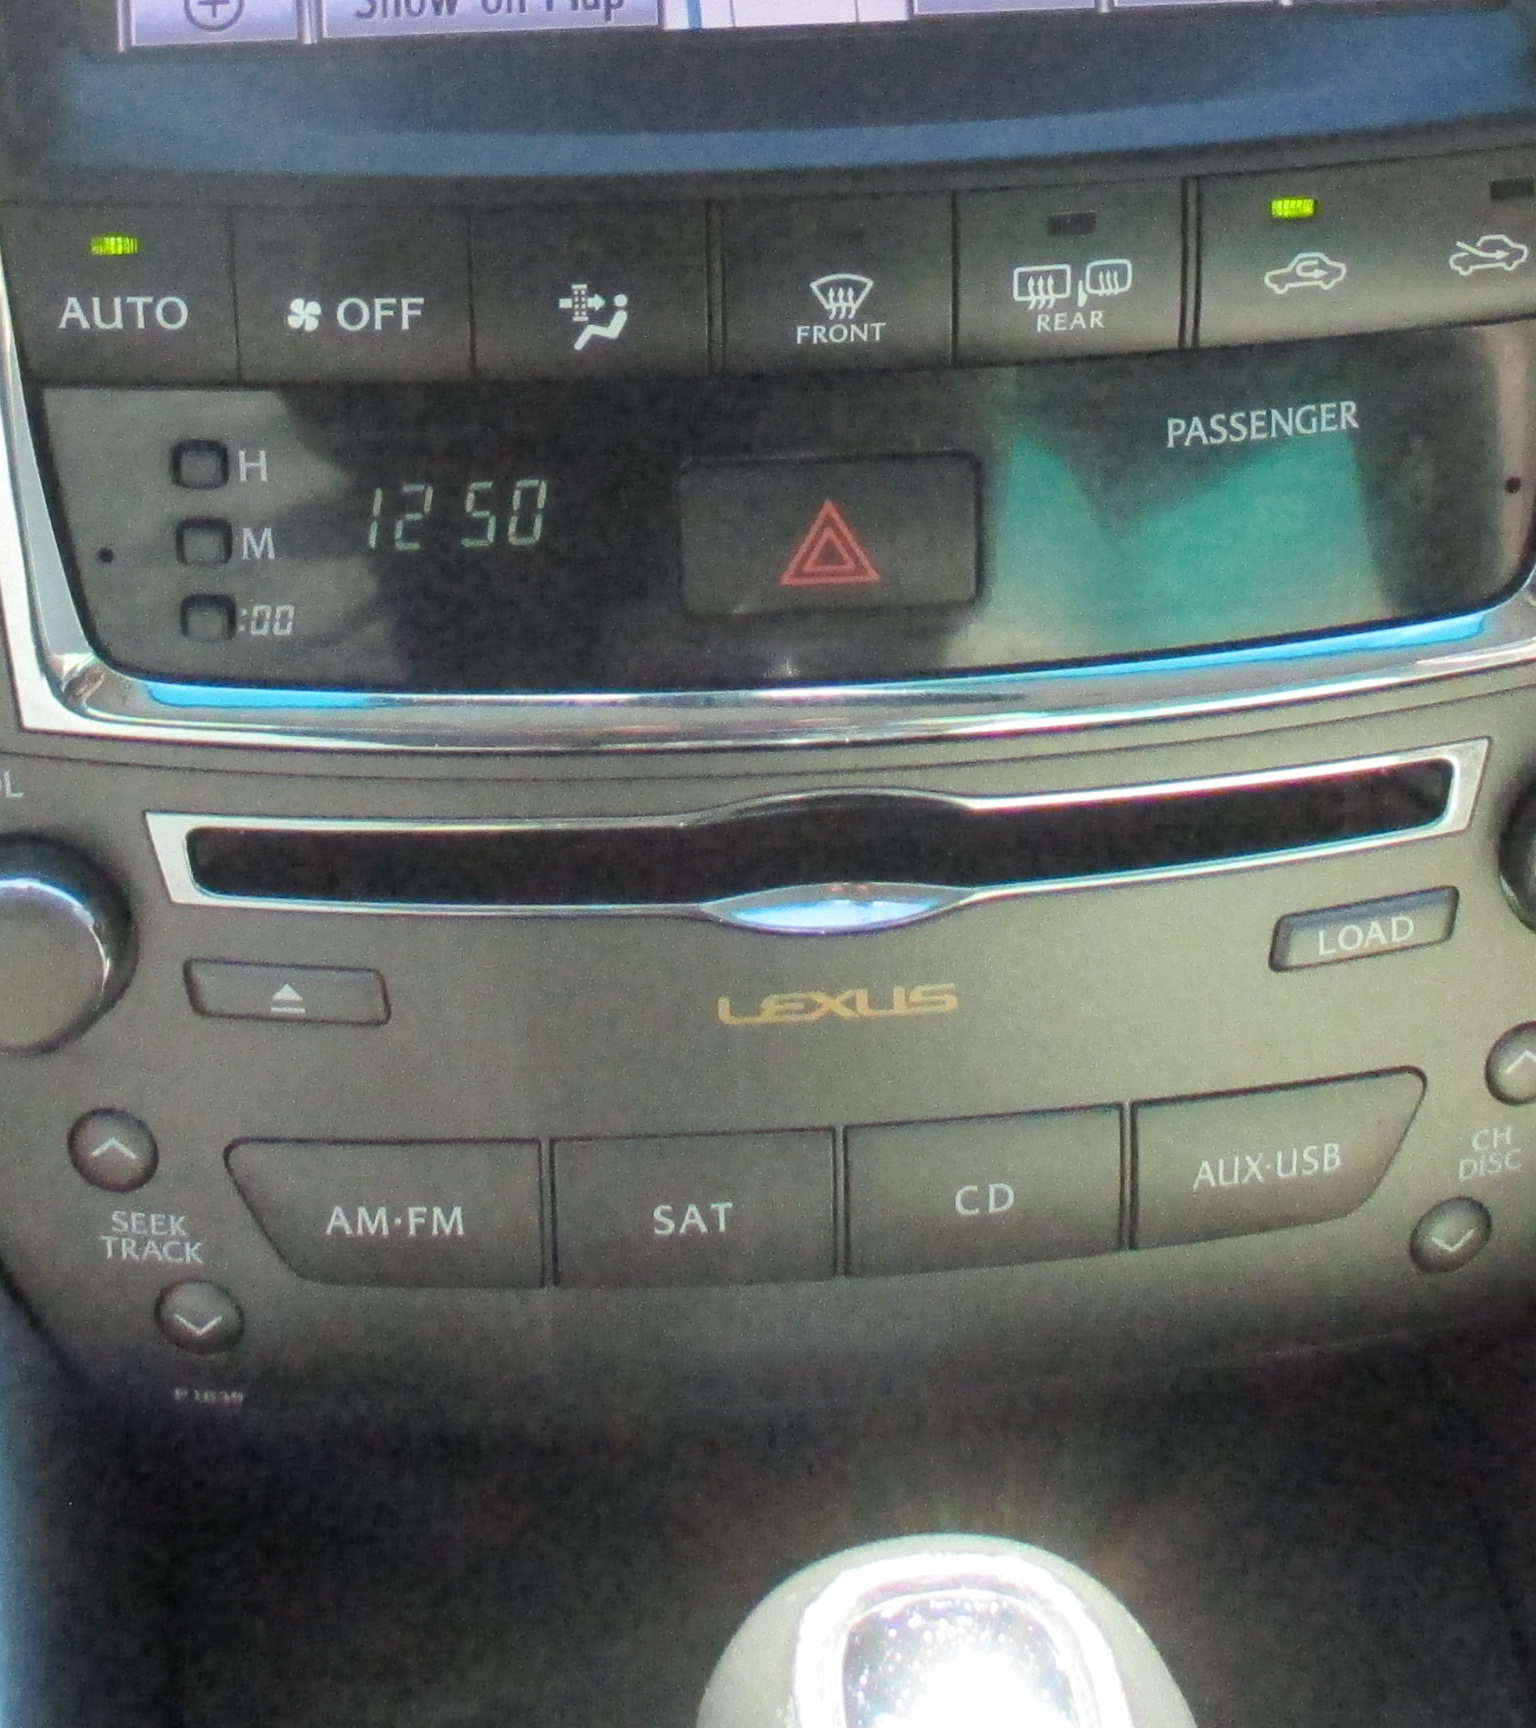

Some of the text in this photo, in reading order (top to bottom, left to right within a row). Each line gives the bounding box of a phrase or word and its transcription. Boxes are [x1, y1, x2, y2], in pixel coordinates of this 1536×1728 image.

[57, 294, 190, 332] AUTO
[335, 296, 425, 333] OFF
[1036, 309, 1106, 333] REAR
[795, 321, 886, 345] FRONT
[1165, 399, 1361, 450] PASSENGER
[237, 450, 269, 485] H
[241, 526, 276, 560] M
[1315, 913, 1416, 957] LOAD
[716, 981, 959, 1026] LEXUS
[1470, 1123, 1515, 1157] CH
[1456, 1146, 1524, 1186] DISC
[953, 1182, 1016, 1217] CD
[110, 1208, 188, 1237] SEEK
[652, 1200, 733, 1237] SAT
[100, 1233, 204, 1266] TRACK
